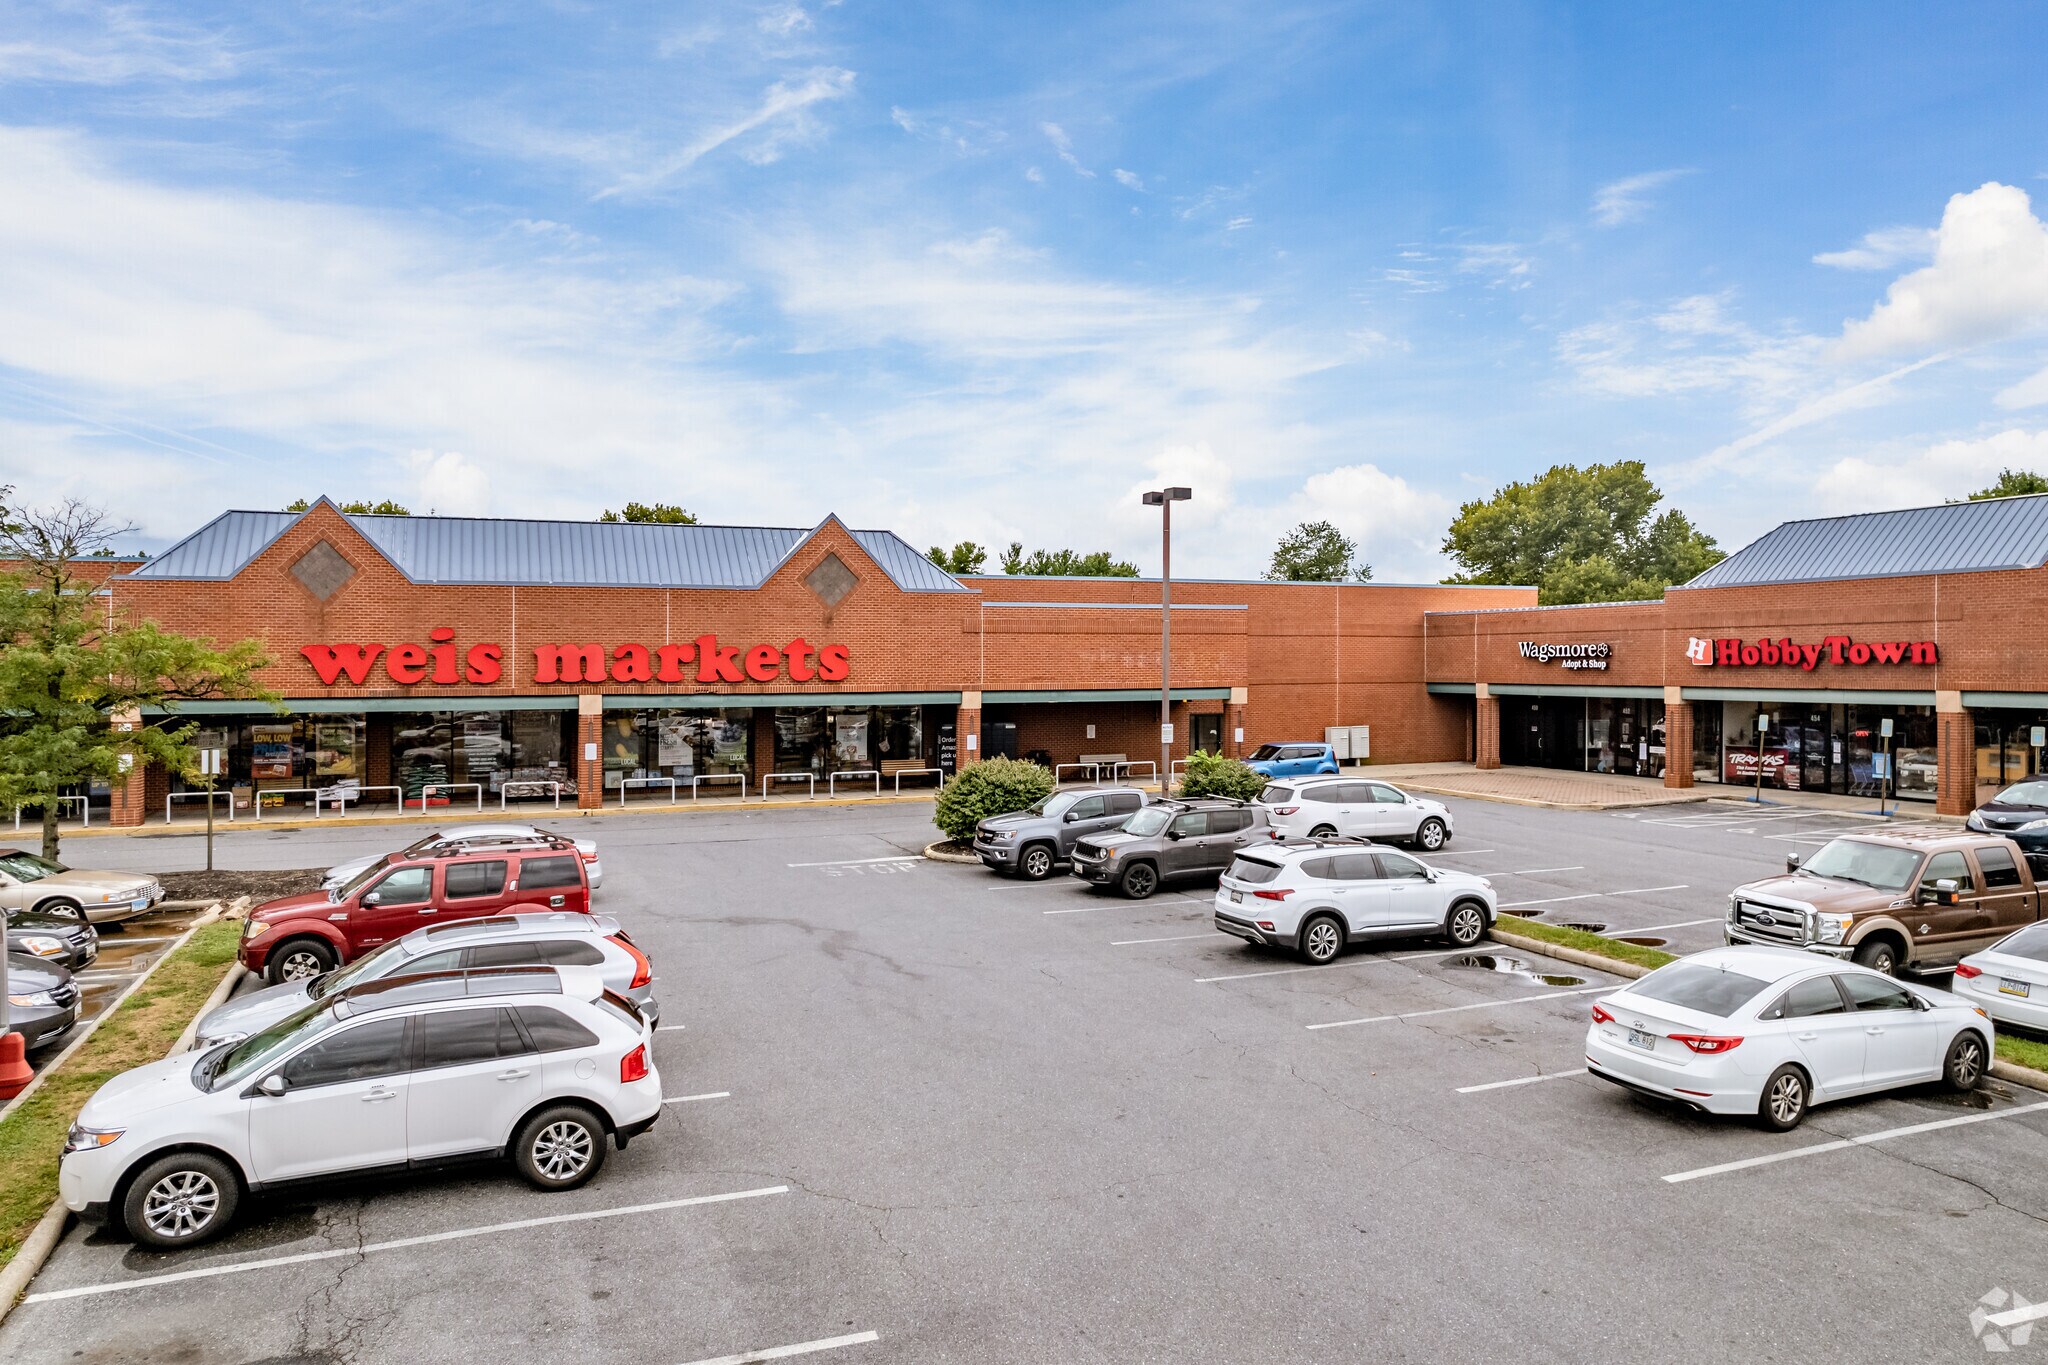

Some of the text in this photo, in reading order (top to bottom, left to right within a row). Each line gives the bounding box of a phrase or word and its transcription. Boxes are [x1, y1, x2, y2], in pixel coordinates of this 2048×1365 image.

[301, 627, 850, 685] weis markets
[1518, 642, 1597, 662] Wagsmore
[1717, 636, 1938, 671] HobbyTown
[1561, 660, 1606, 670] Adopt & Shop
[253, 734, 291, 744] LOW, LOW
